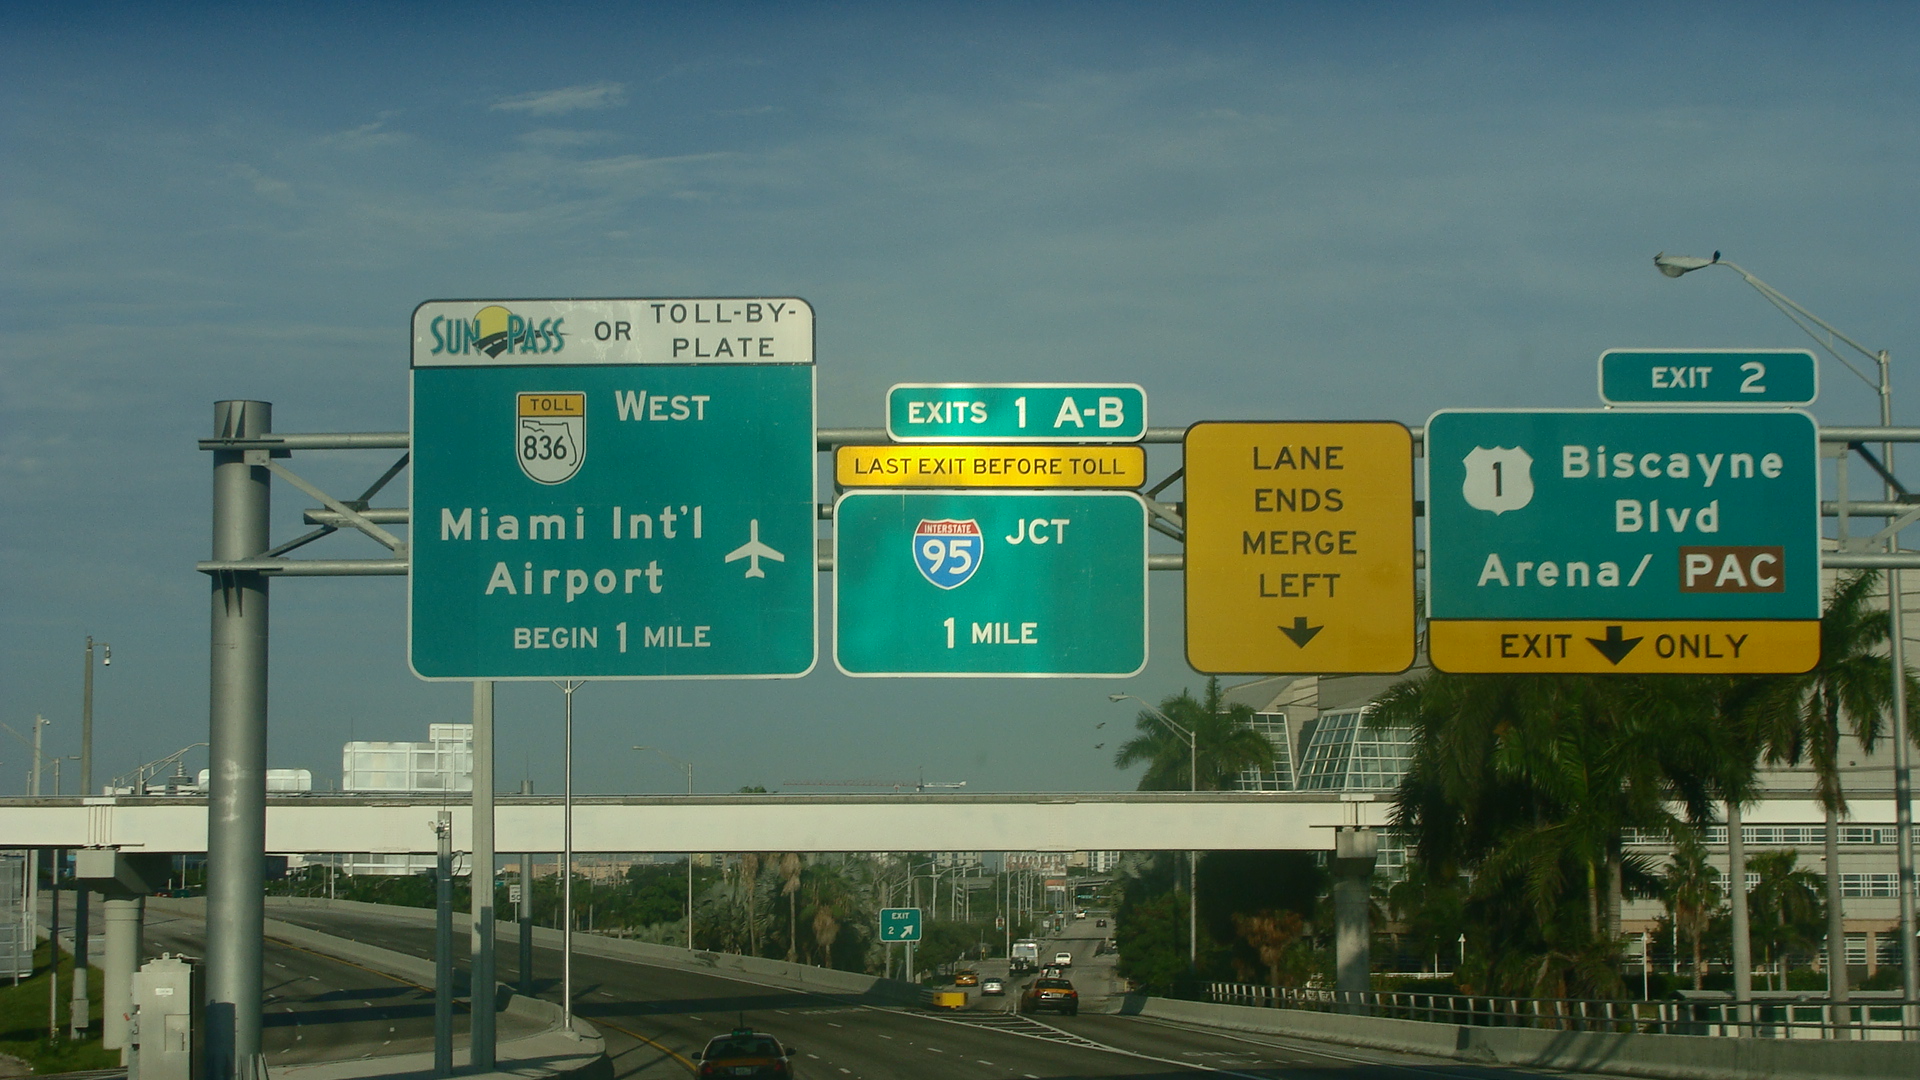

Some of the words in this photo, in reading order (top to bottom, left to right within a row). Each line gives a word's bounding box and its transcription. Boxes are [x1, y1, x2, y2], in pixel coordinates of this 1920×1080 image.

[651, 303, 796, 324] TOLL-BY-
[595, 322, 631, 340] OR
[673, 337, 775, 358] PLATE
[1652, 367, 1712, 388] EXIT
[1740, 362, 1766, 393] 2
[530, 398, 574, 412] TOLL
[615, 391, 710, 421] WEST
[908, 402, 988, 423] EXITS
[1015, 397, 1026, 428] 1
[1054, 397, 1124, 428] A-B
[523, 436, 567, 460] 836
[1253, 446, 1344, 470] LANE
[856, 458, 912, 474] LAST
[919, 458, 967, 474] EXIT
[973, 459, 1062, 474] BEFORE
[1070, 458, 1125, 474] TOLL
[1563, 445, 1783, 487] Biscayne
[1492, 462, 1502, 497] 1
[1255, 488, 1344, 512] ENDS
[441, 507, 584, 540] Miami
[613, 505, 702, 539] Int'l
[1616, 500, 1718, 533] Blvd
[925, 525, 971, 533] INTERSTATE
[1005, 519, 1070, 544] JCT
[1242, 531, 1357, 554] MERGE
[923, 539, 971, 574] 95
[485, 560, 662, 602] Airport
[1685, 554, 1778, 588] PAC
[1260, 574, 1340, 598] LEFT
[514, 627, 598, 648] BEGIN
[617, 622, 626, 652] 1
[644, 626, 710, 647] MILE
[944, 617, 954, 648] 1
[972, 622, 1038, 644] MILE
[1501, 634, 1572, 658] EXIT
[1655, 634, 1748, 658] ONLY
[888, 926, 894, 934] 2
